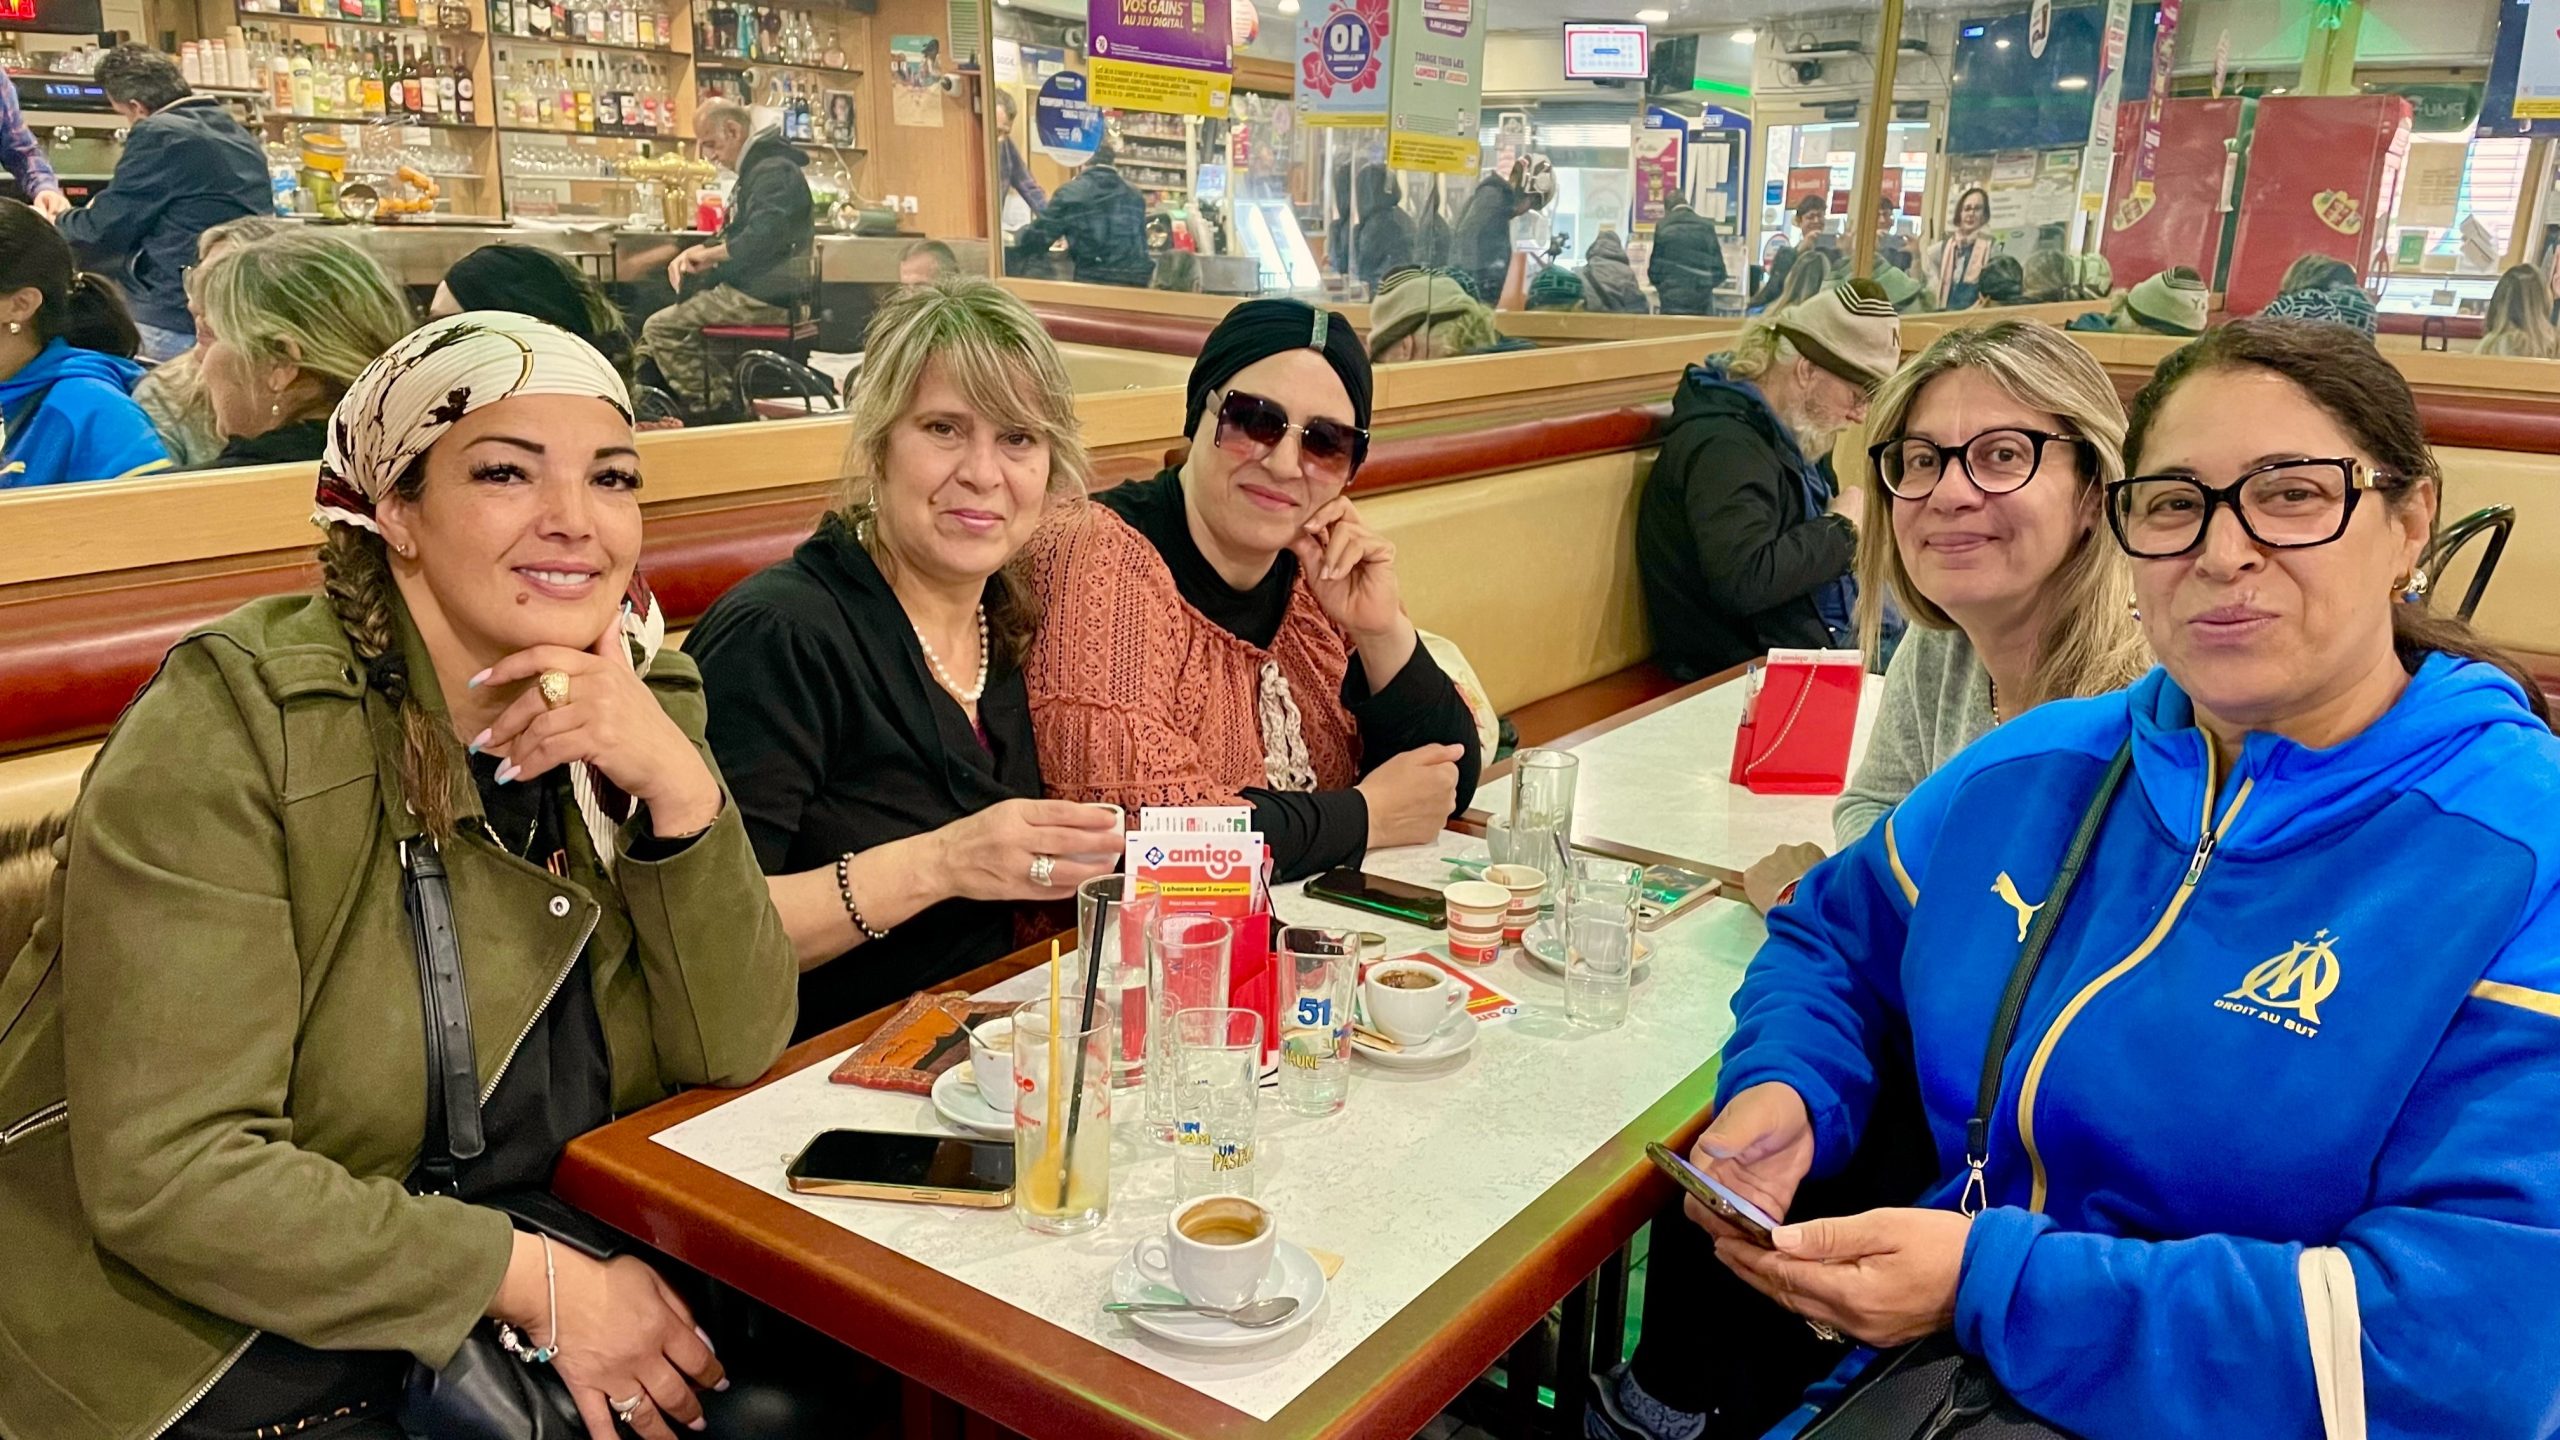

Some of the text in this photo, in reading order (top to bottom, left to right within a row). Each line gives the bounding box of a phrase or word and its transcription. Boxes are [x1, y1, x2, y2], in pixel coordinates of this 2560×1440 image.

[1122, 0, 1184, 16] VOS GAINS
[1123, 15, 1185, 28] AU JEU DIGITAL
[1168, 843, 1243, 875] amigo
[1297, 997, 1332, 1026] 51
[2213, 999, 2318, 1039] DROIT AU BUT
[1219, 1143, 1235, 1157] UN
